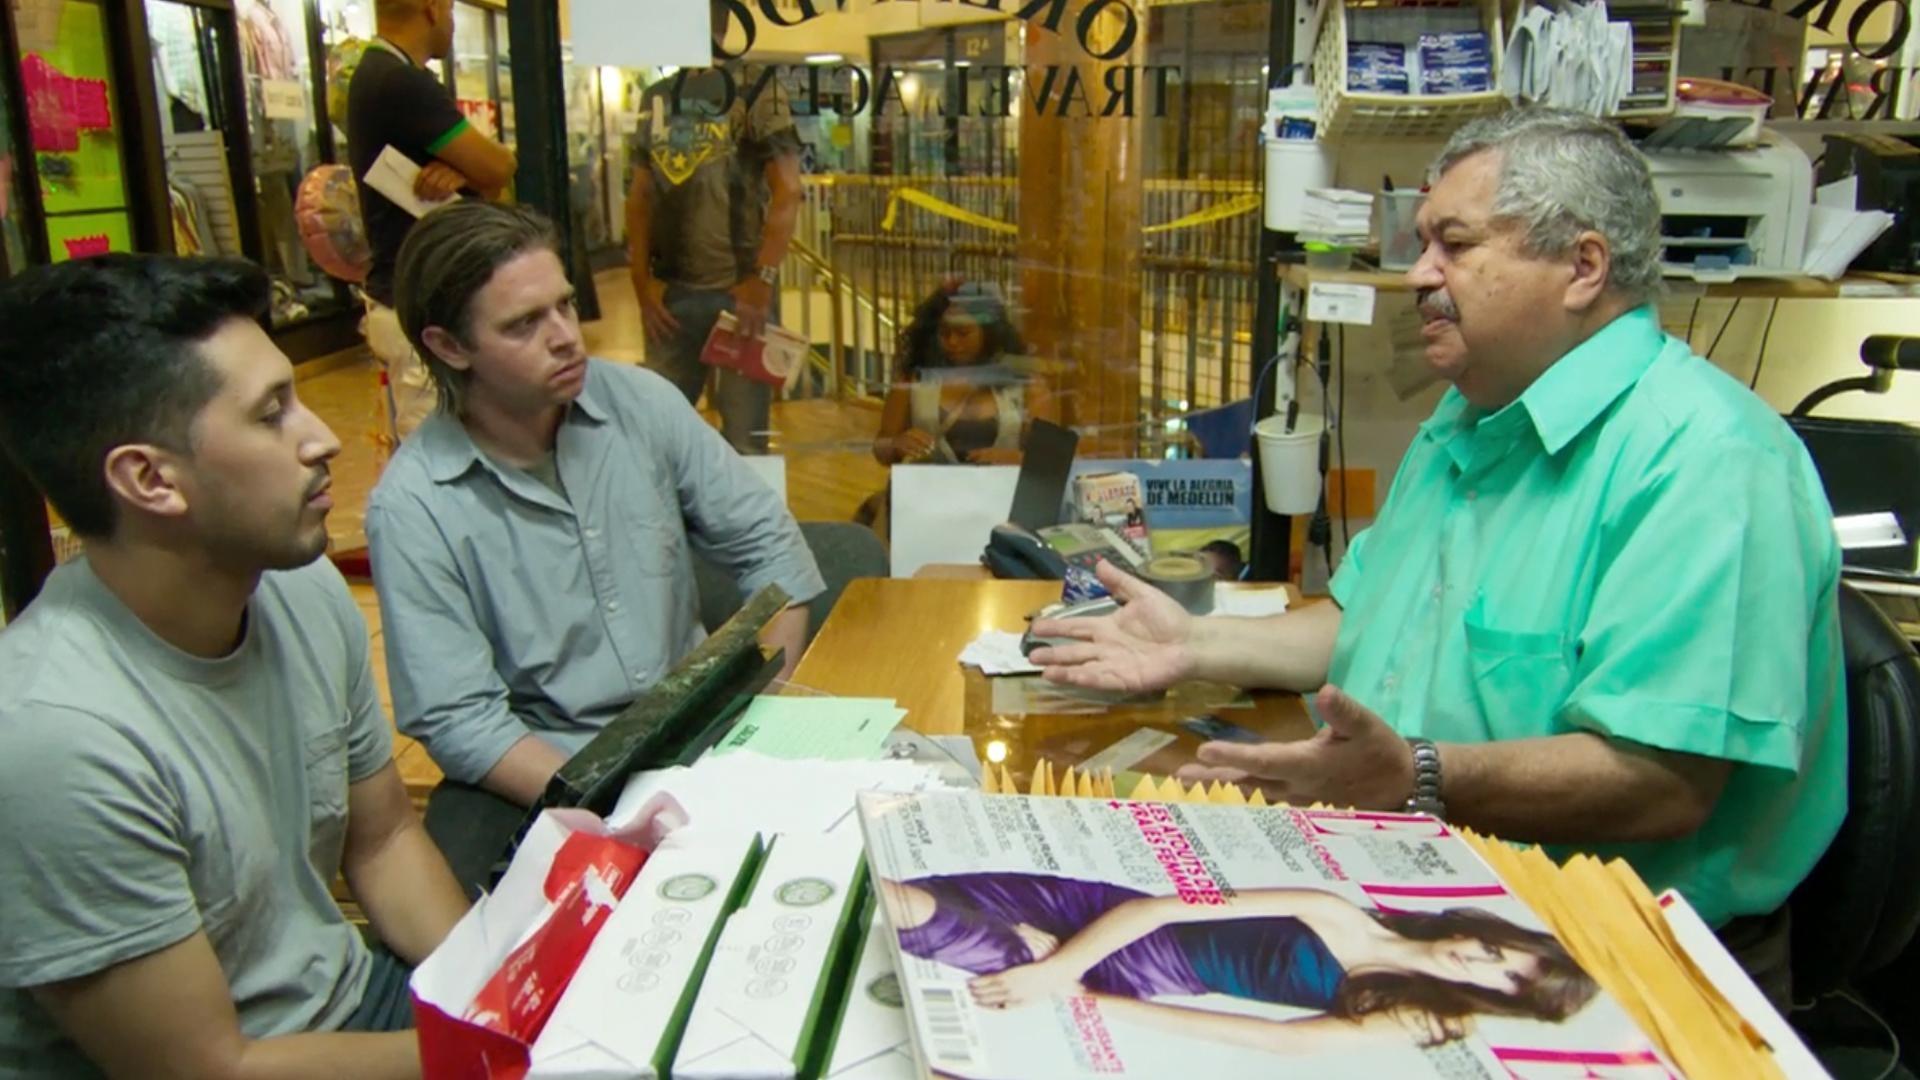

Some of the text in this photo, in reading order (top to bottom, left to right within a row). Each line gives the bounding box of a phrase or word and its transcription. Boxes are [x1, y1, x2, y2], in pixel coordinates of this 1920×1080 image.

[1146, 479, 1171, 490] VIVE
[1173, 479, 1186, 490] LA
[1146, 491, 1164, 506] DE
[1124, 800, 1205, 905] VRAIES FEMMES
[1144, 801, 1173, 821] LES
[1159, 825, 1209, 875] ATOUTS
[1192, 879, 1228, 905] DES
